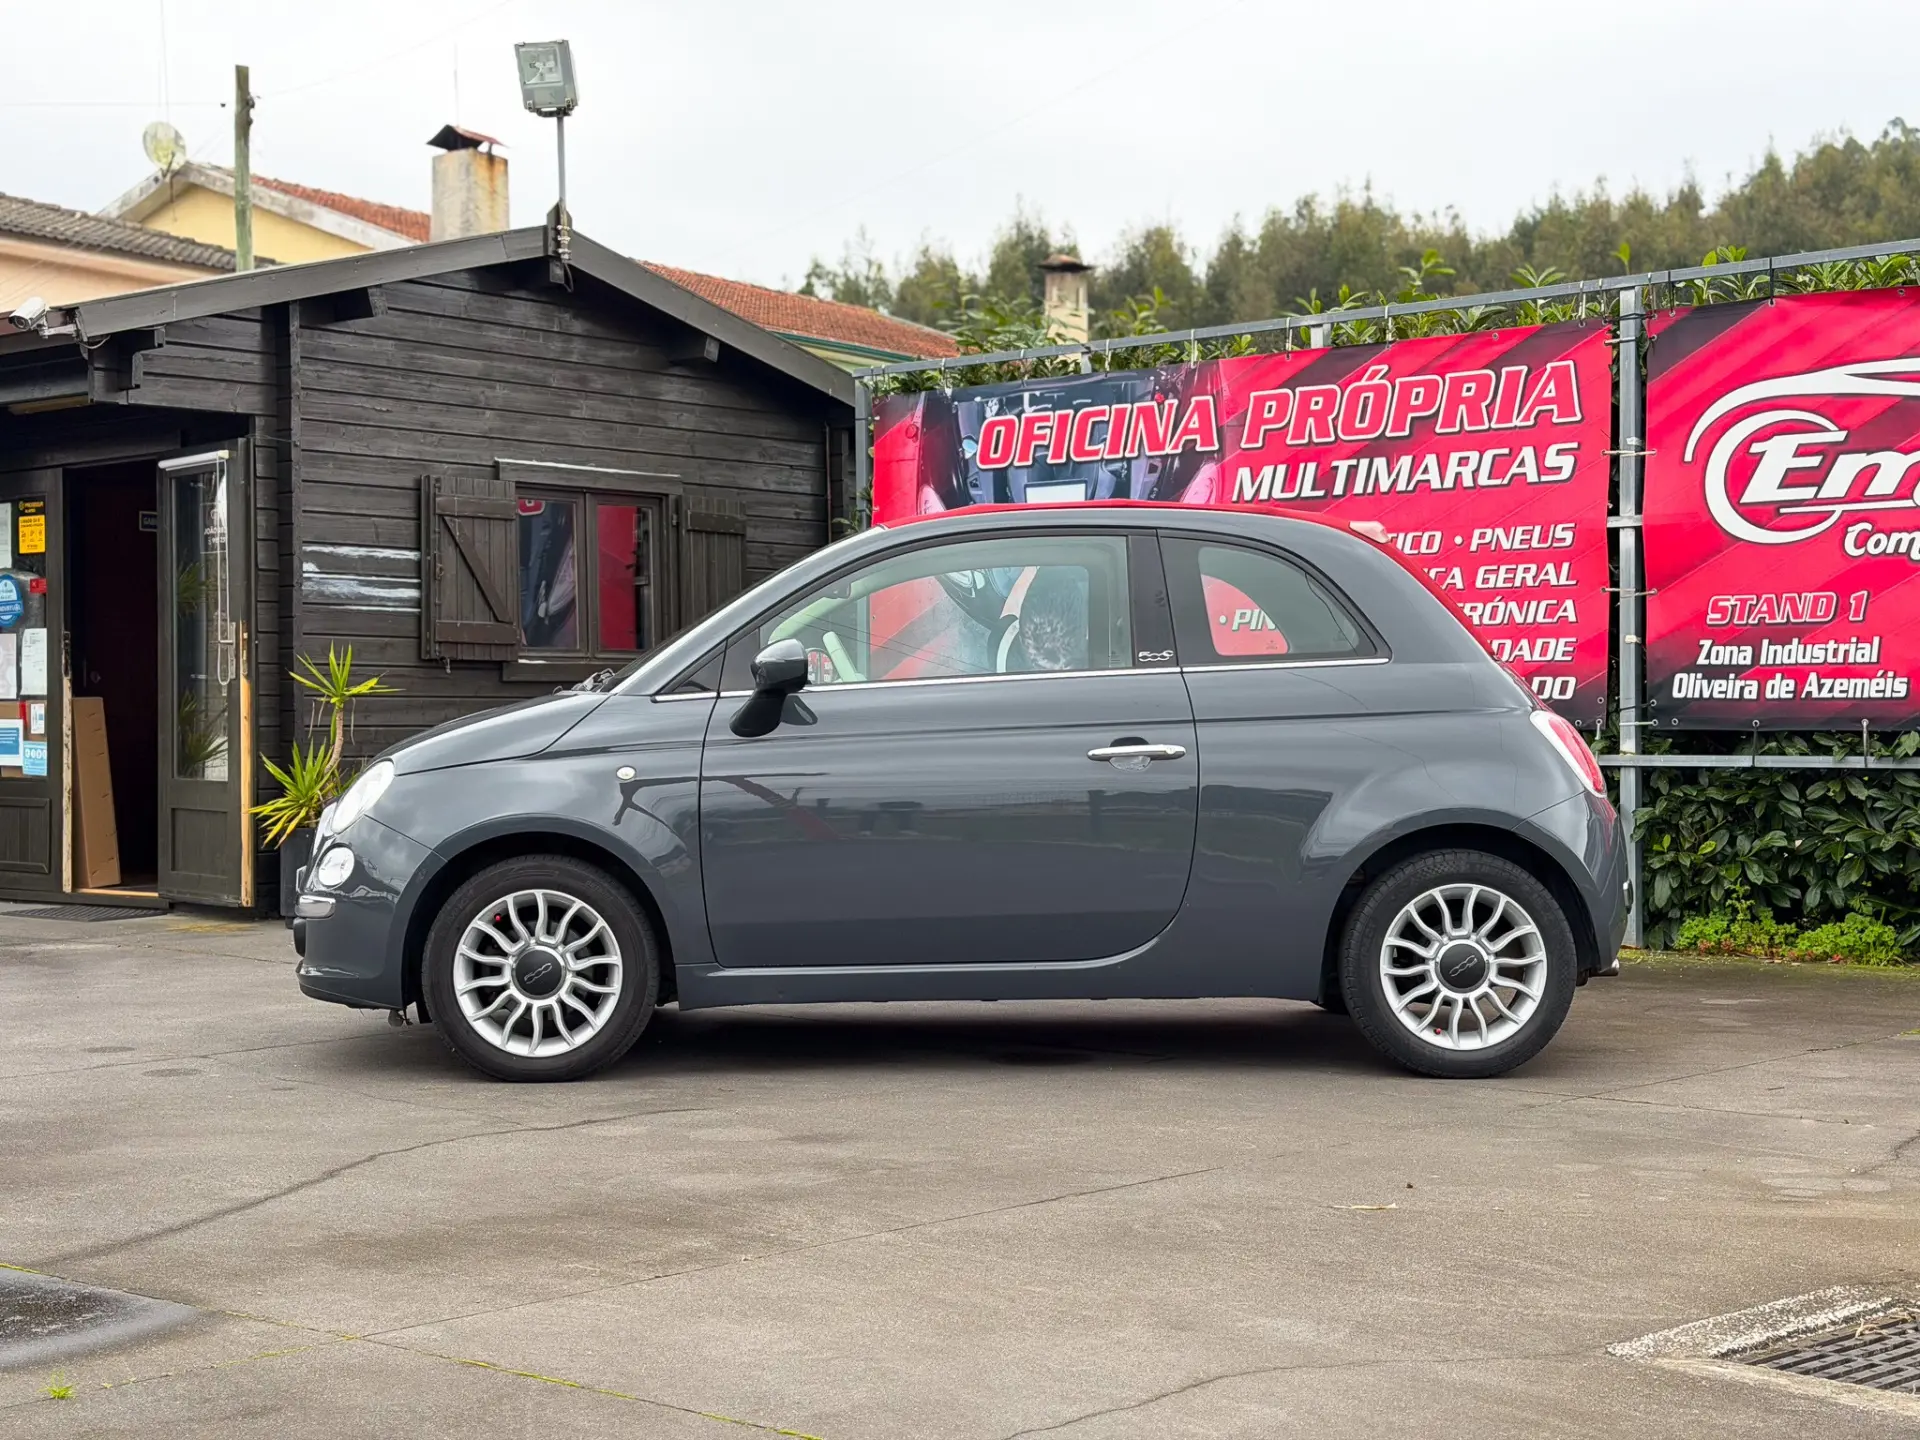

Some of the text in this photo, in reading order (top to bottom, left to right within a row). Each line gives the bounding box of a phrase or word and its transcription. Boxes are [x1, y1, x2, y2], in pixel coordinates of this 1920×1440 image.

[976, 360, 1582, 469] OFICINA PRÓPRIA
[1231, 441, 1579, 502] MULTIMARCAS
[1469, 523, 1577, 552] PNEUS
[1475, 562, 1577, 590] GERAL
[1457, 595, 1577, 626] RÓNICA
[1706, 590, 1870, 625] STAND 1
[1487, 637, 1577, 662] DADE
[1696, 635, 1881, 666] Zona Industrial
[1524, 676, 1577, 700] DO
[1671, 669, 1909, 700] Oliveira de Azeméis
